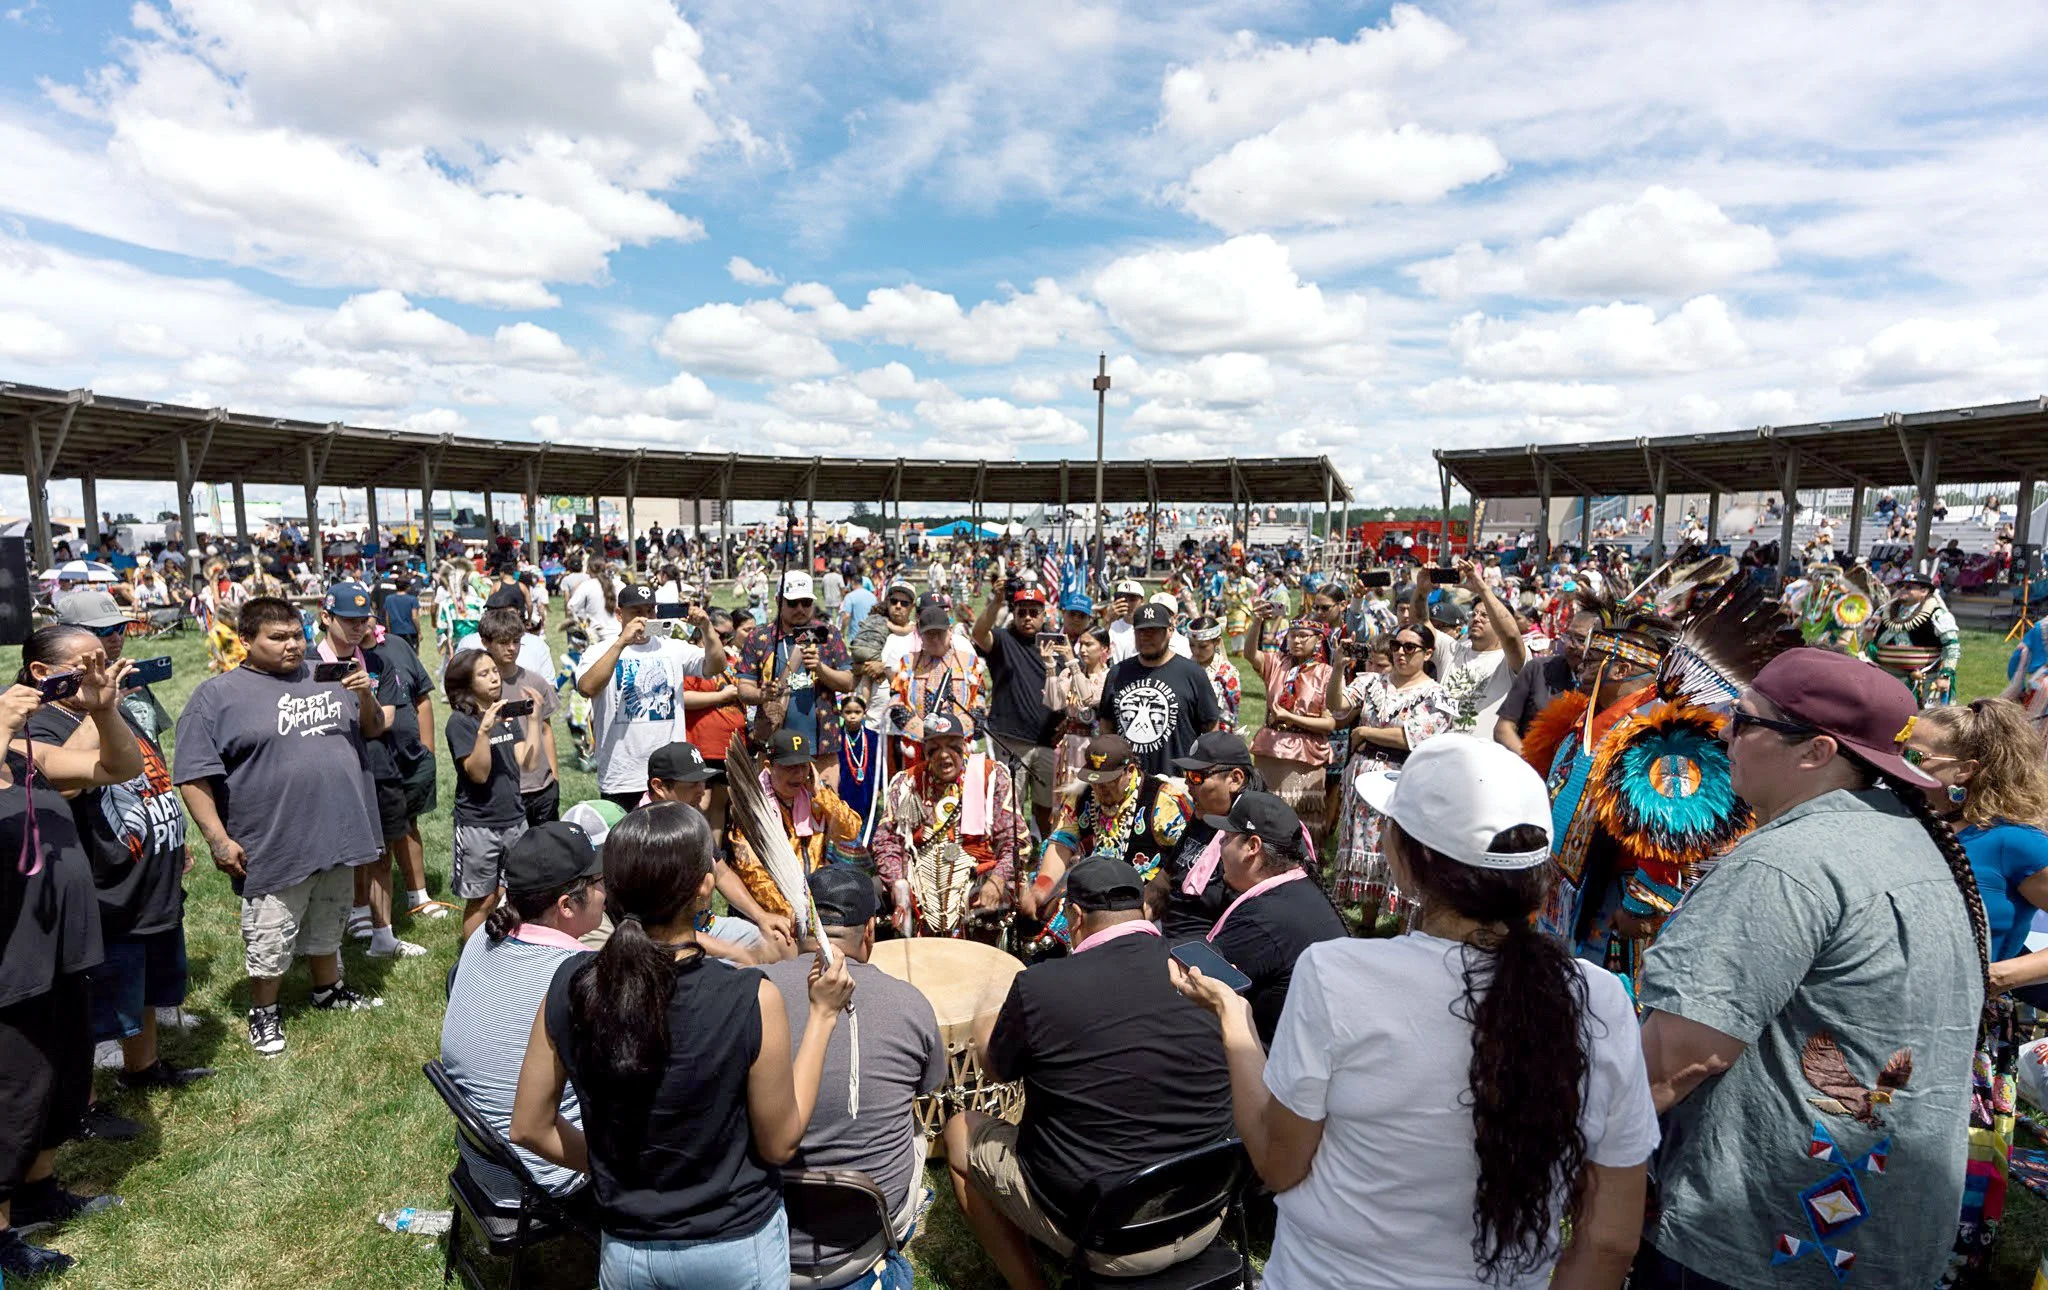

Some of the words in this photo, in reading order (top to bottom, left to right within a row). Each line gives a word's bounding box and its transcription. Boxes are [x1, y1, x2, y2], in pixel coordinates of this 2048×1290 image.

[1143, 607, 1155, 619] NY
[1119, 678, 1152, 697] HUSTLE
[1153, 679, 1176, 700] TRIBE
[277, 690, 333, 714] STREET
[277, 701, 343, 736] CAPITALIST
[1132, 739, 1164, 754] NATIVE
[1162, 702, 1180, 743] AMERICA
[792, 736, 802, 751] P
[690, 748, 704, 764] NY
